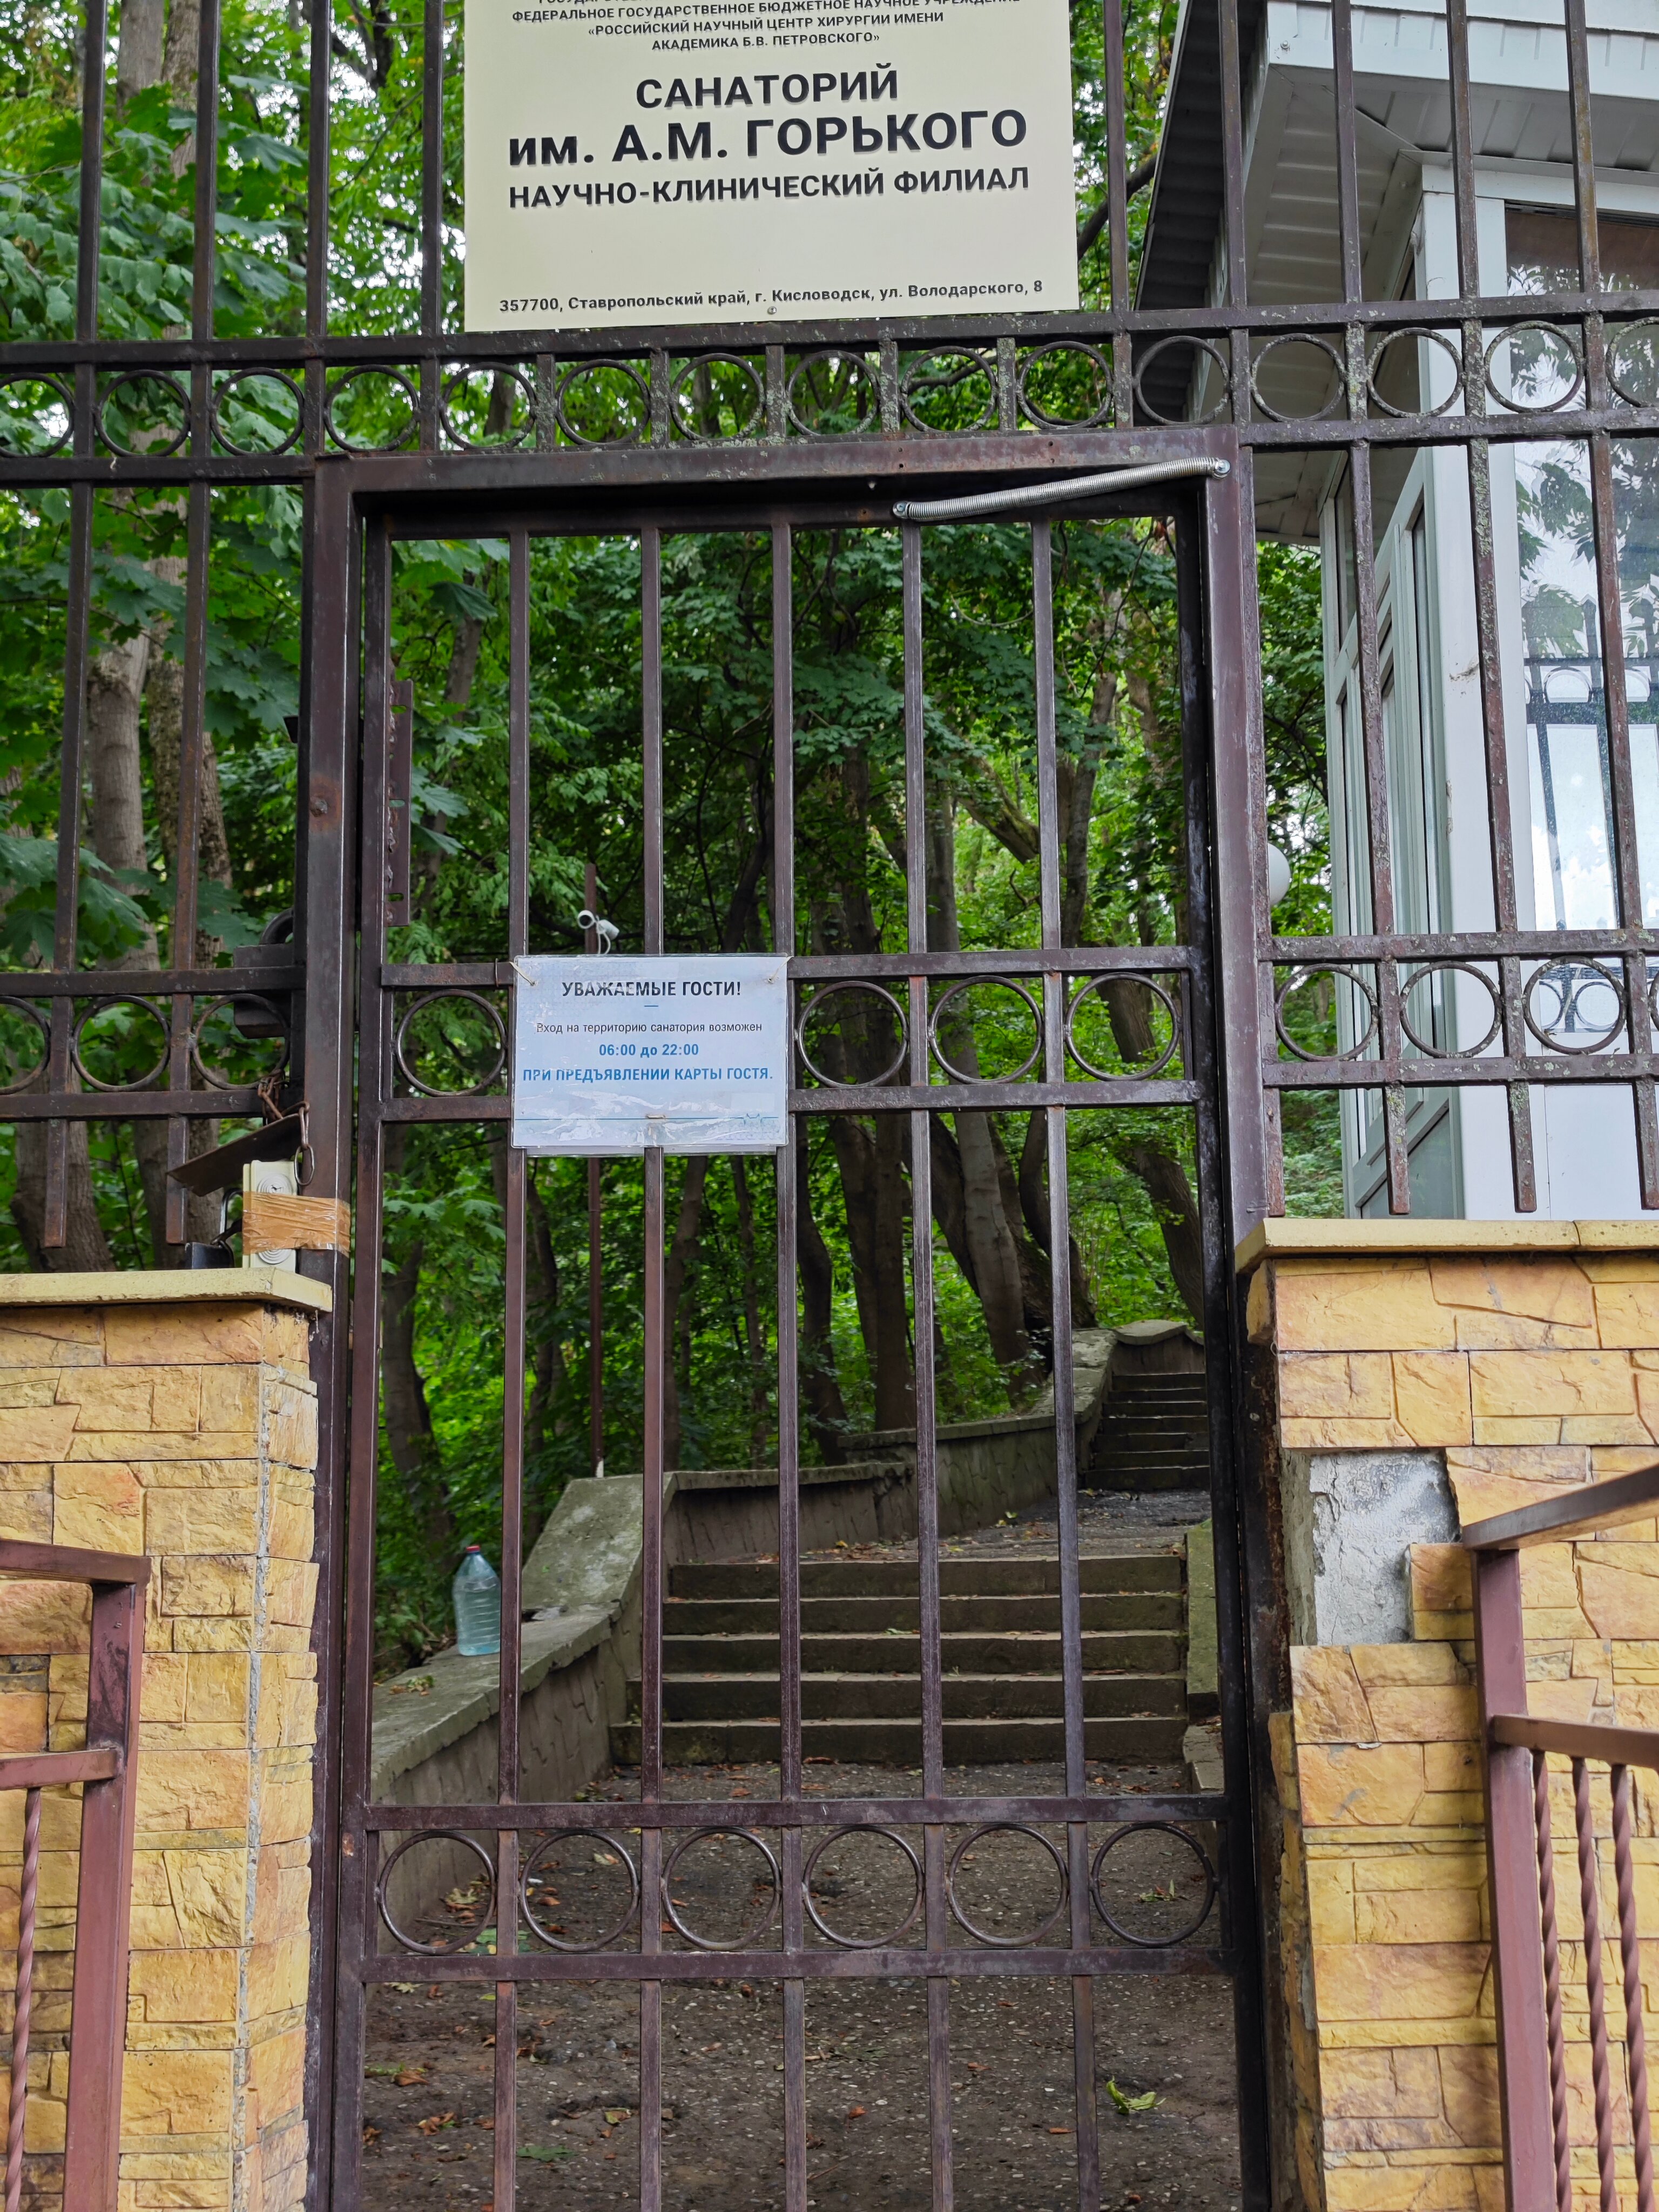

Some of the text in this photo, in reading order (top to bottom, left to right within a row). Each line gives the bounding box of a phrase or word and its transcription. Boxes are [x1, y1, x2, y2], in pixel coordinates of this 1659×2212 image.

[512, 9, 615, 22] ФЕДЕРАЛЬНОЕ
[618, 3, 755, 18] ГОСУДАРСТВЕННОЕ
[759, 0, 851, 14] БЮДЖЕТНОЕ
[589, 12, 944, 36] «РОССИЙСКИЙ НАУЧНЫЙ ЦЕНТР ХИРУРГИИ ИМЕНИ
[652, 32, 880, 51] АКАДЕМИКА Б.В. ПЕТРОВСКОГО»
[636, 62, 898, 109] САНАТОРИЙ
[611, 122, 727, 163] А.М.
[747, 109, 1027, 157] ГОРЬКОГО
[509, 166, 1029, 208] НАУЧНО-КЛИНИЧЕСКИЙ ФИЛИАЛ
[500, 280, 1043, 312] 357700, Ставропольский край, г. Кисловодск, ул. Володарского, 8
[562, 981, 741, 996] УВАЖАЕМЫЕ ГОСТИ!
[536, 1023, 762, 1035] Вход на территорию санатория возможен
[599, 1043, 699, 1058] 06:00 до 22:00
[523, 1067, 773, 1083] ПРИ ПРЕДЪЯВЛЕНИИ КАРТЫ ГОСТЯ.
